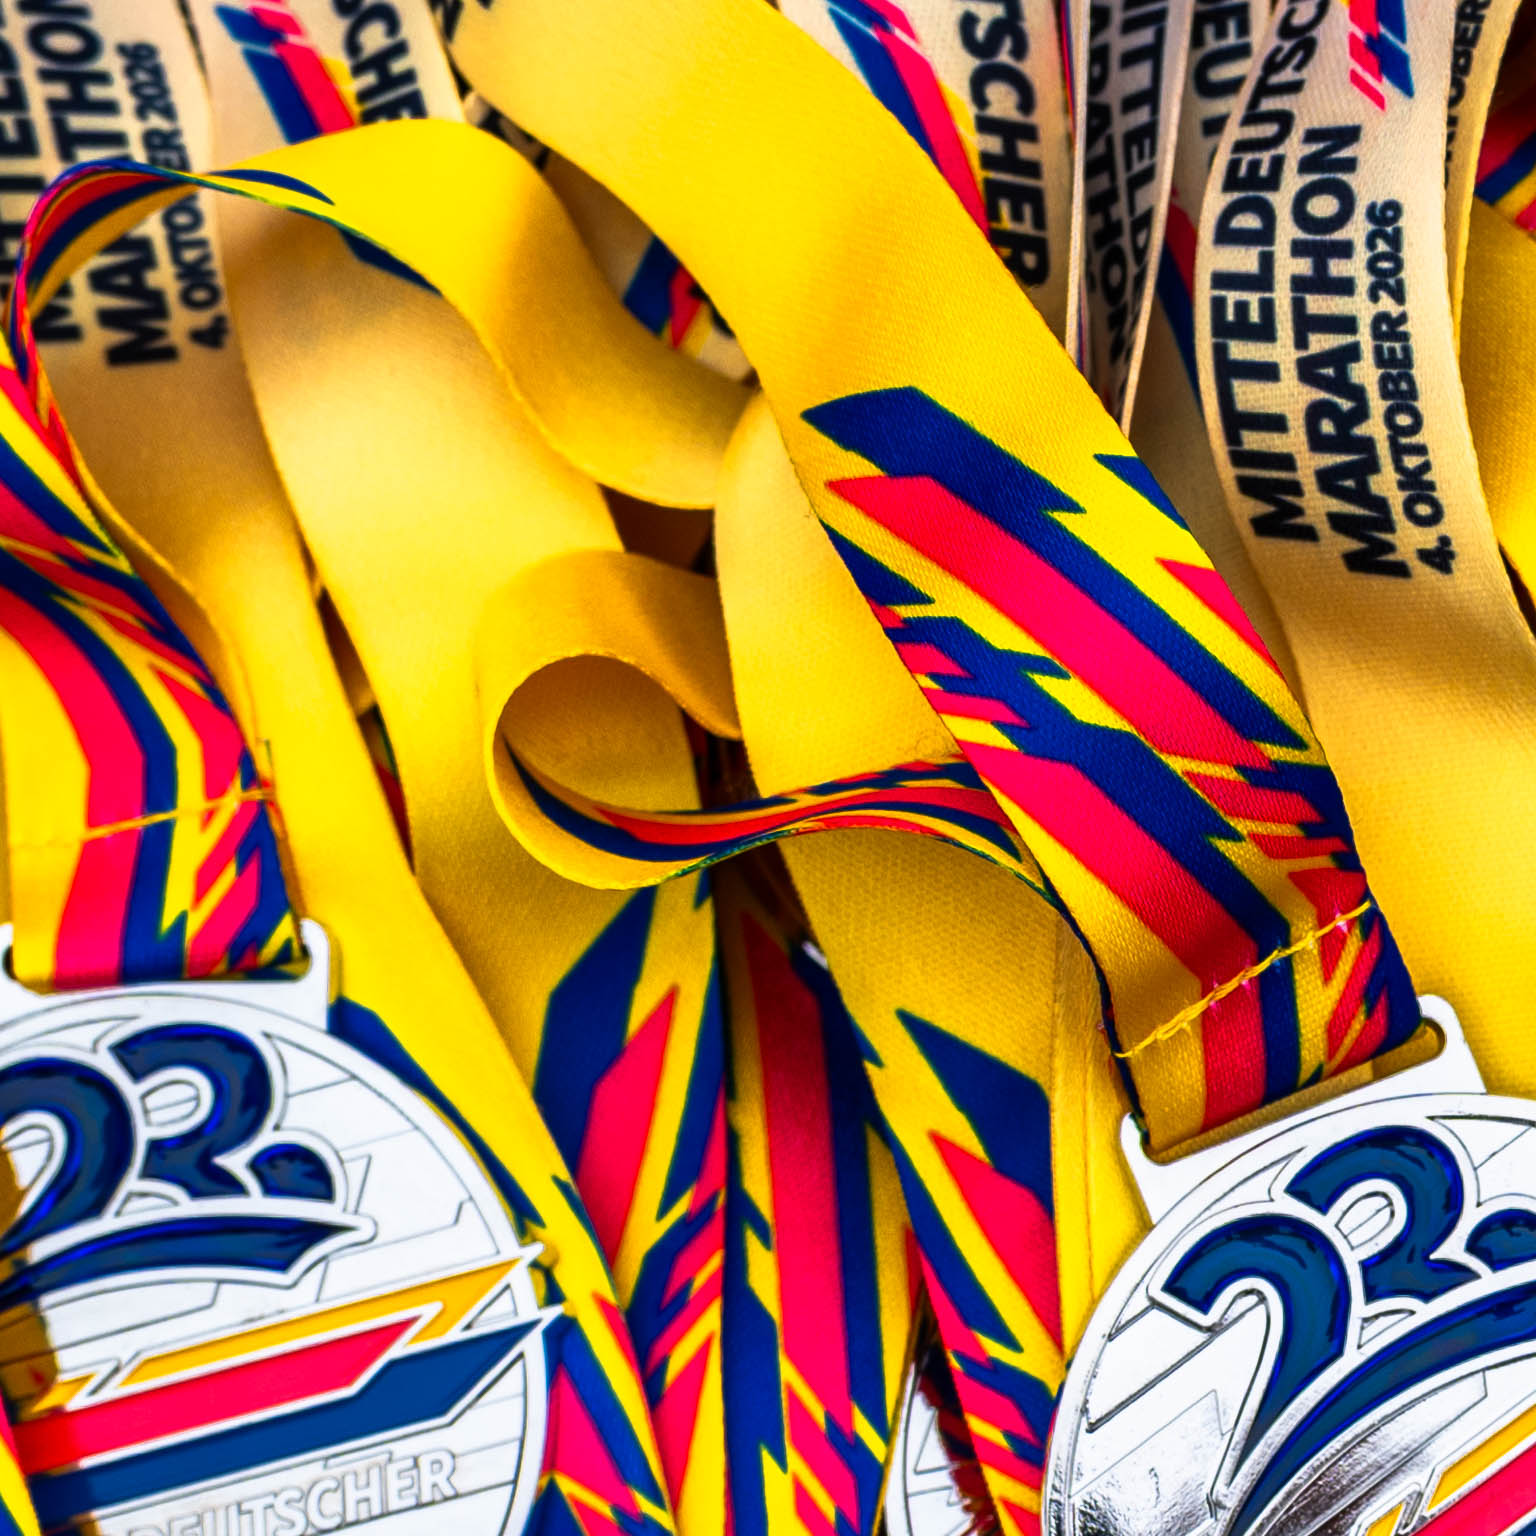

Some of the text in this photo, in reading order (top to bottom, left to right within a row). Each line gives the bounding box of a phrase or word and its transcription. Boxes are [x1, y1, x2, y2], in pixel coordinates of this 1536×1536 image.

[15, 0, 179, 365] MATHO
[116, 42, 178, 121] 2026
[1210, 0, 1328, 542] MITTELDEUTSC
[1290, 124, 1412, 579] MARATHON
[1365, 199, 1455, 575] 4. OKTOBER 2026
